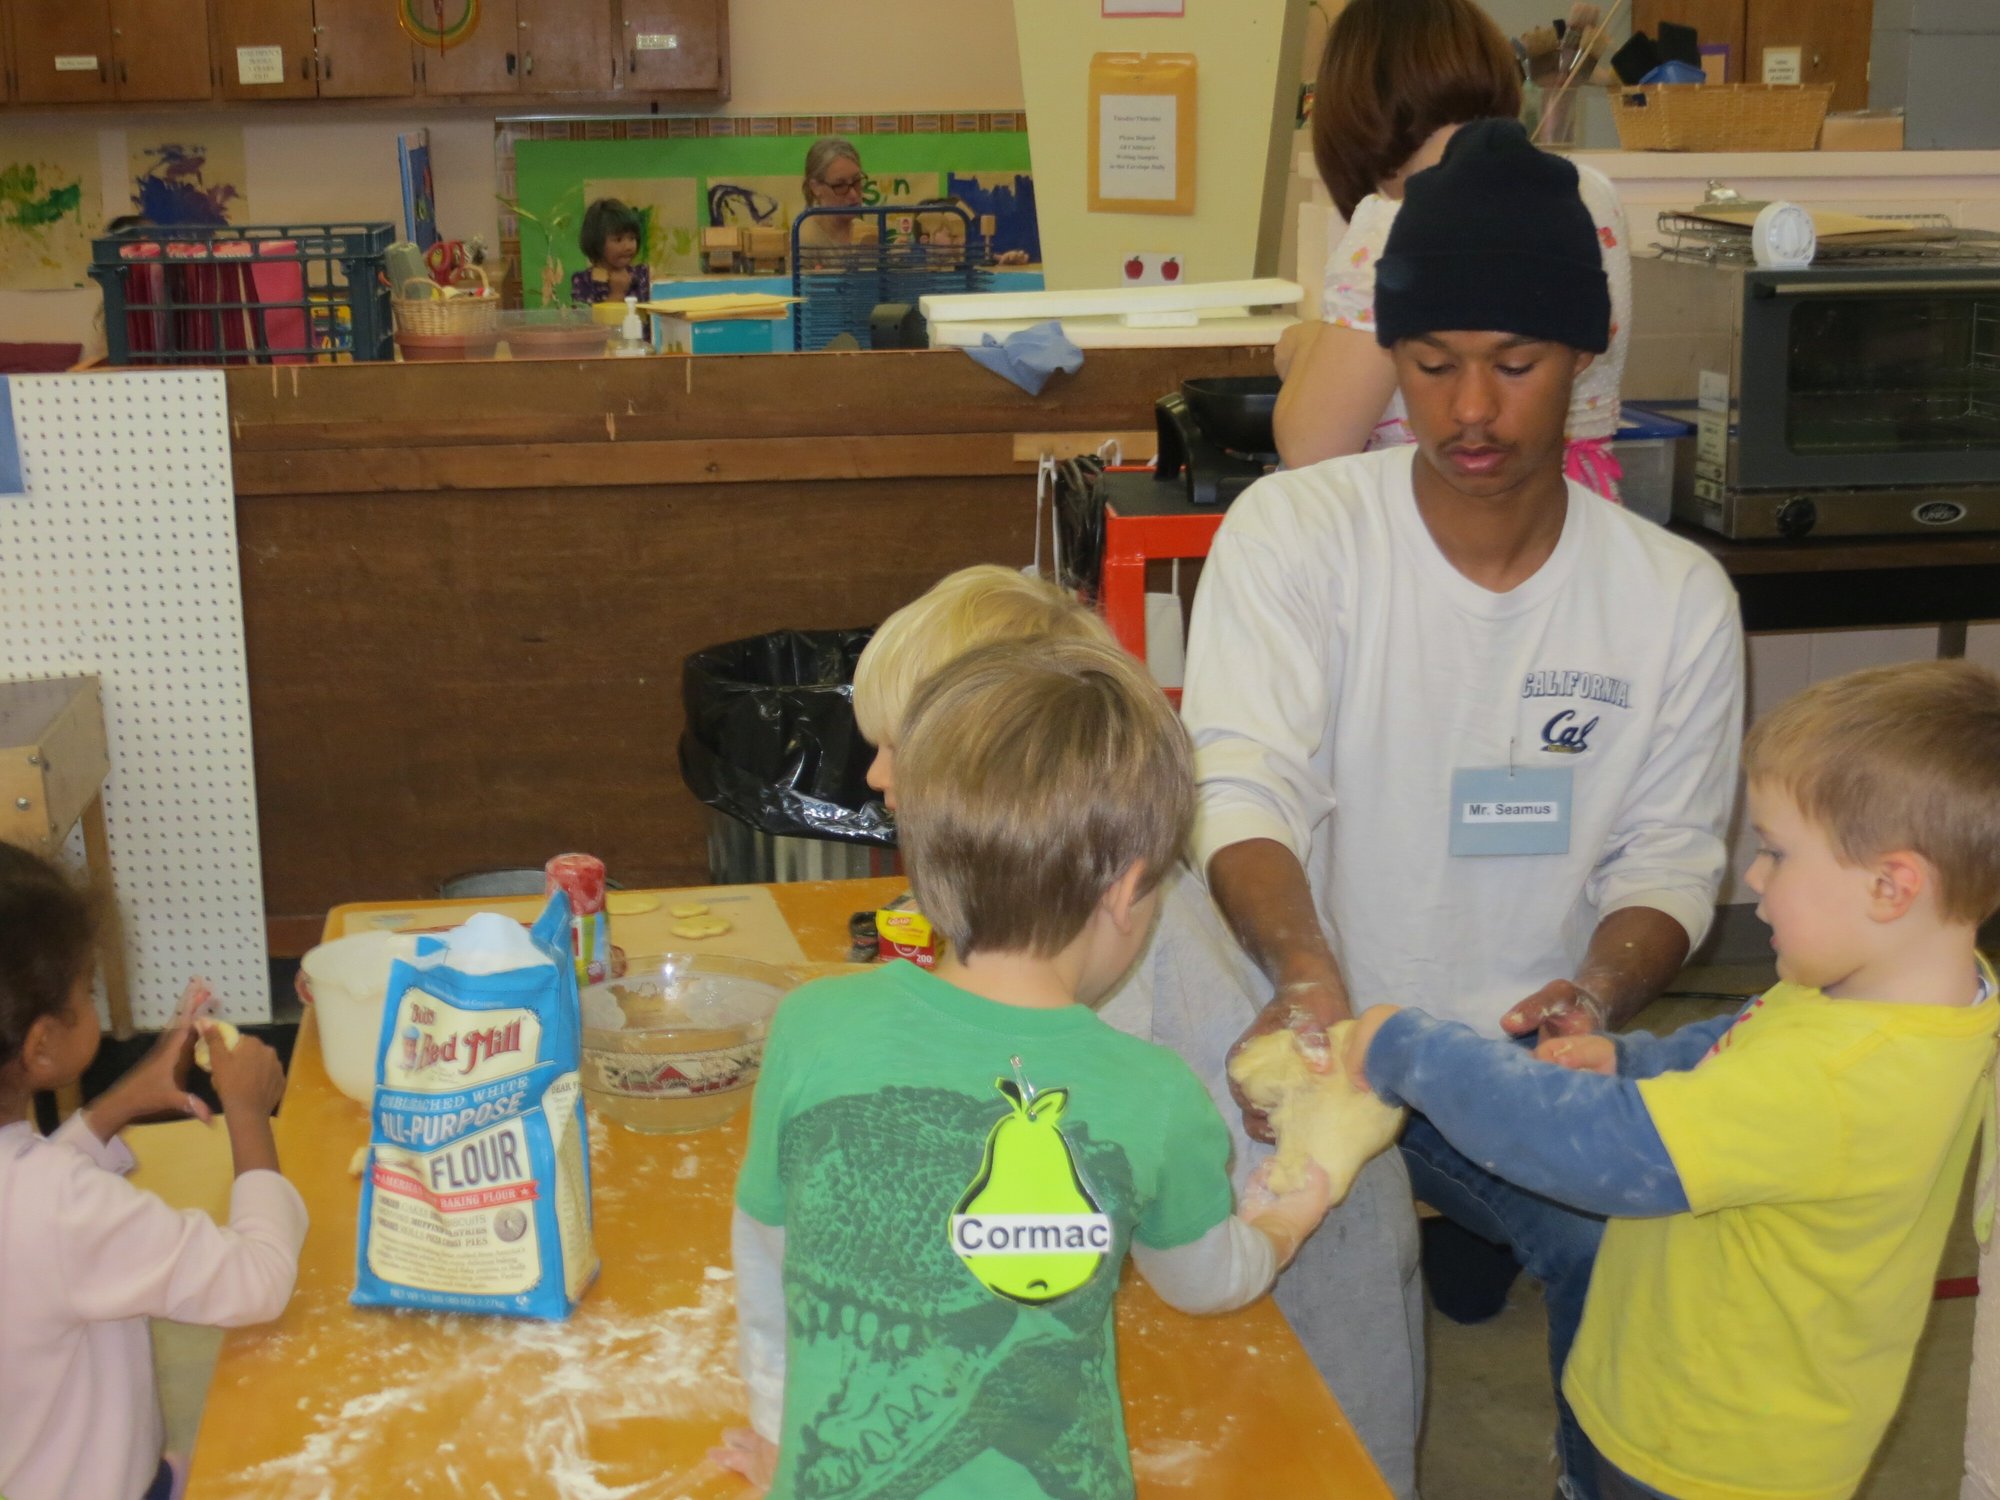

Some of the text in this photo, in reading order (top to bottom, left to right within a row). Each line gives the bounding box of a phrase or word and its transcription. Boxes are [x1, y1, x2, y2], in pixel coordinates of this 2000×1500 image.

[1521, 670, 1631, 709] CALIFORNIA
[1541, 709, 1600, 753] Cal
[1468, 803, 1551, 816] Mr. Seamus
[916, 954, 933, 963] 200
[415, 1017, 521, 1075] Red Mill
[472, 1075, 530, 1103] WHITE
[429, 1129, 523, 1190] FLOUR
[440, 1195, 480, 1209] BAKING
[483, 1189, 517, 1203] FLOUR
[957, 1218, 1108, 1250] Cormac
